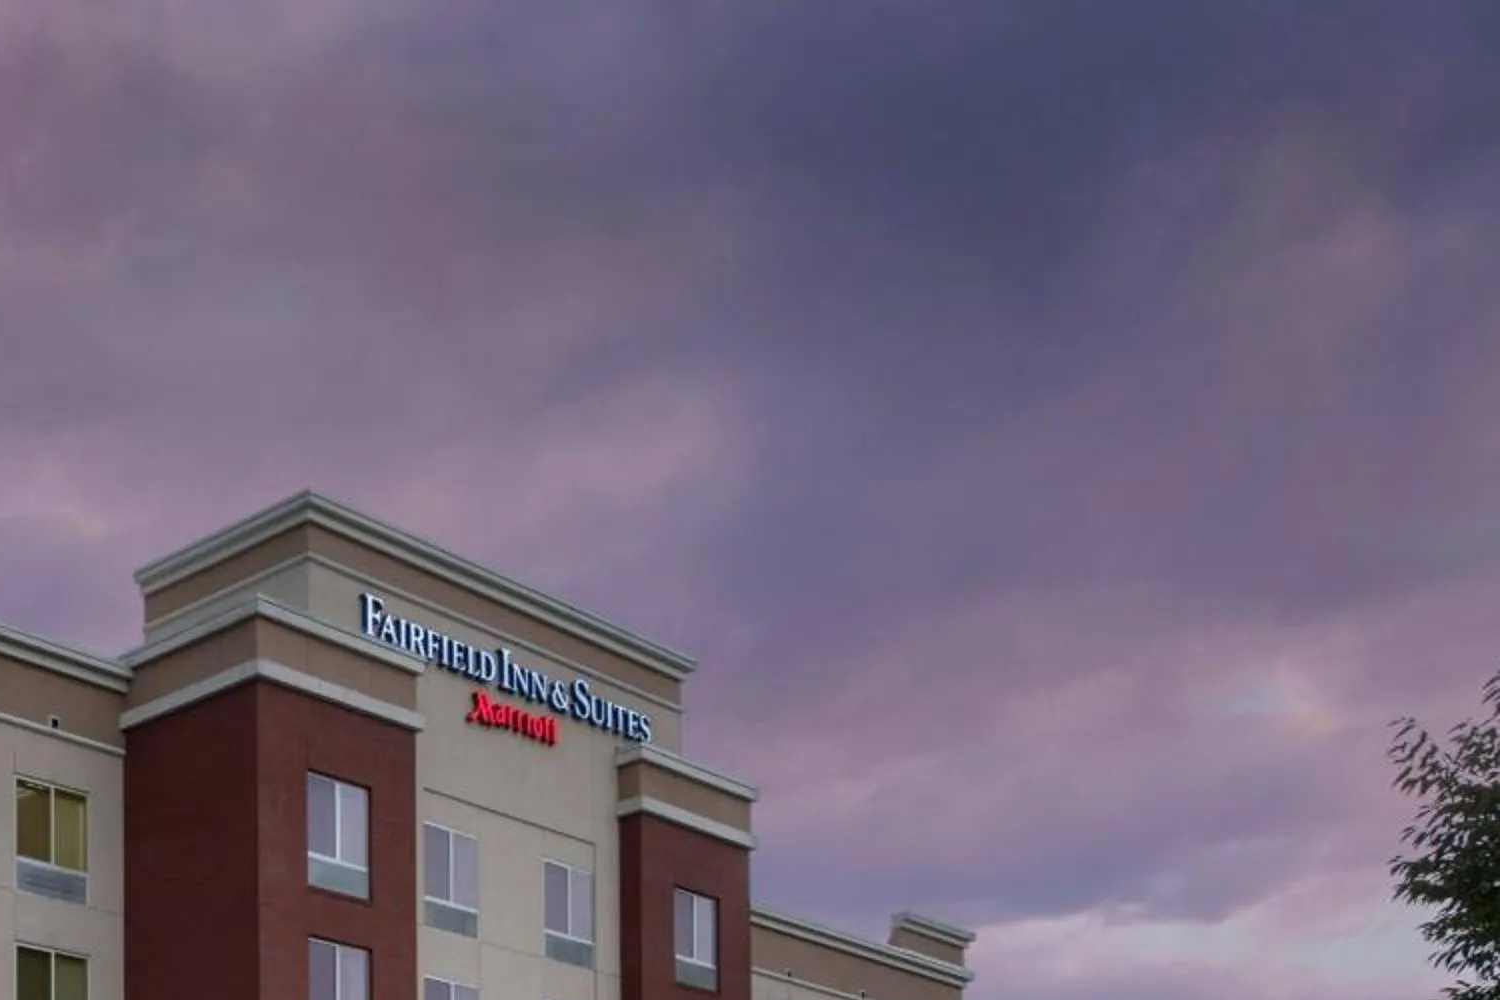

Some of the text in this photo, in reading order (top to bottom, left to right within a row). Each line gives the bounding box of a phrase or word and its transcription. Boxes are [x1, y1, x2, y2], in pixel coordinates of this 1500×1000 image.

[361, 592, 651, 743] FAIRFIELD INN & SUITES
